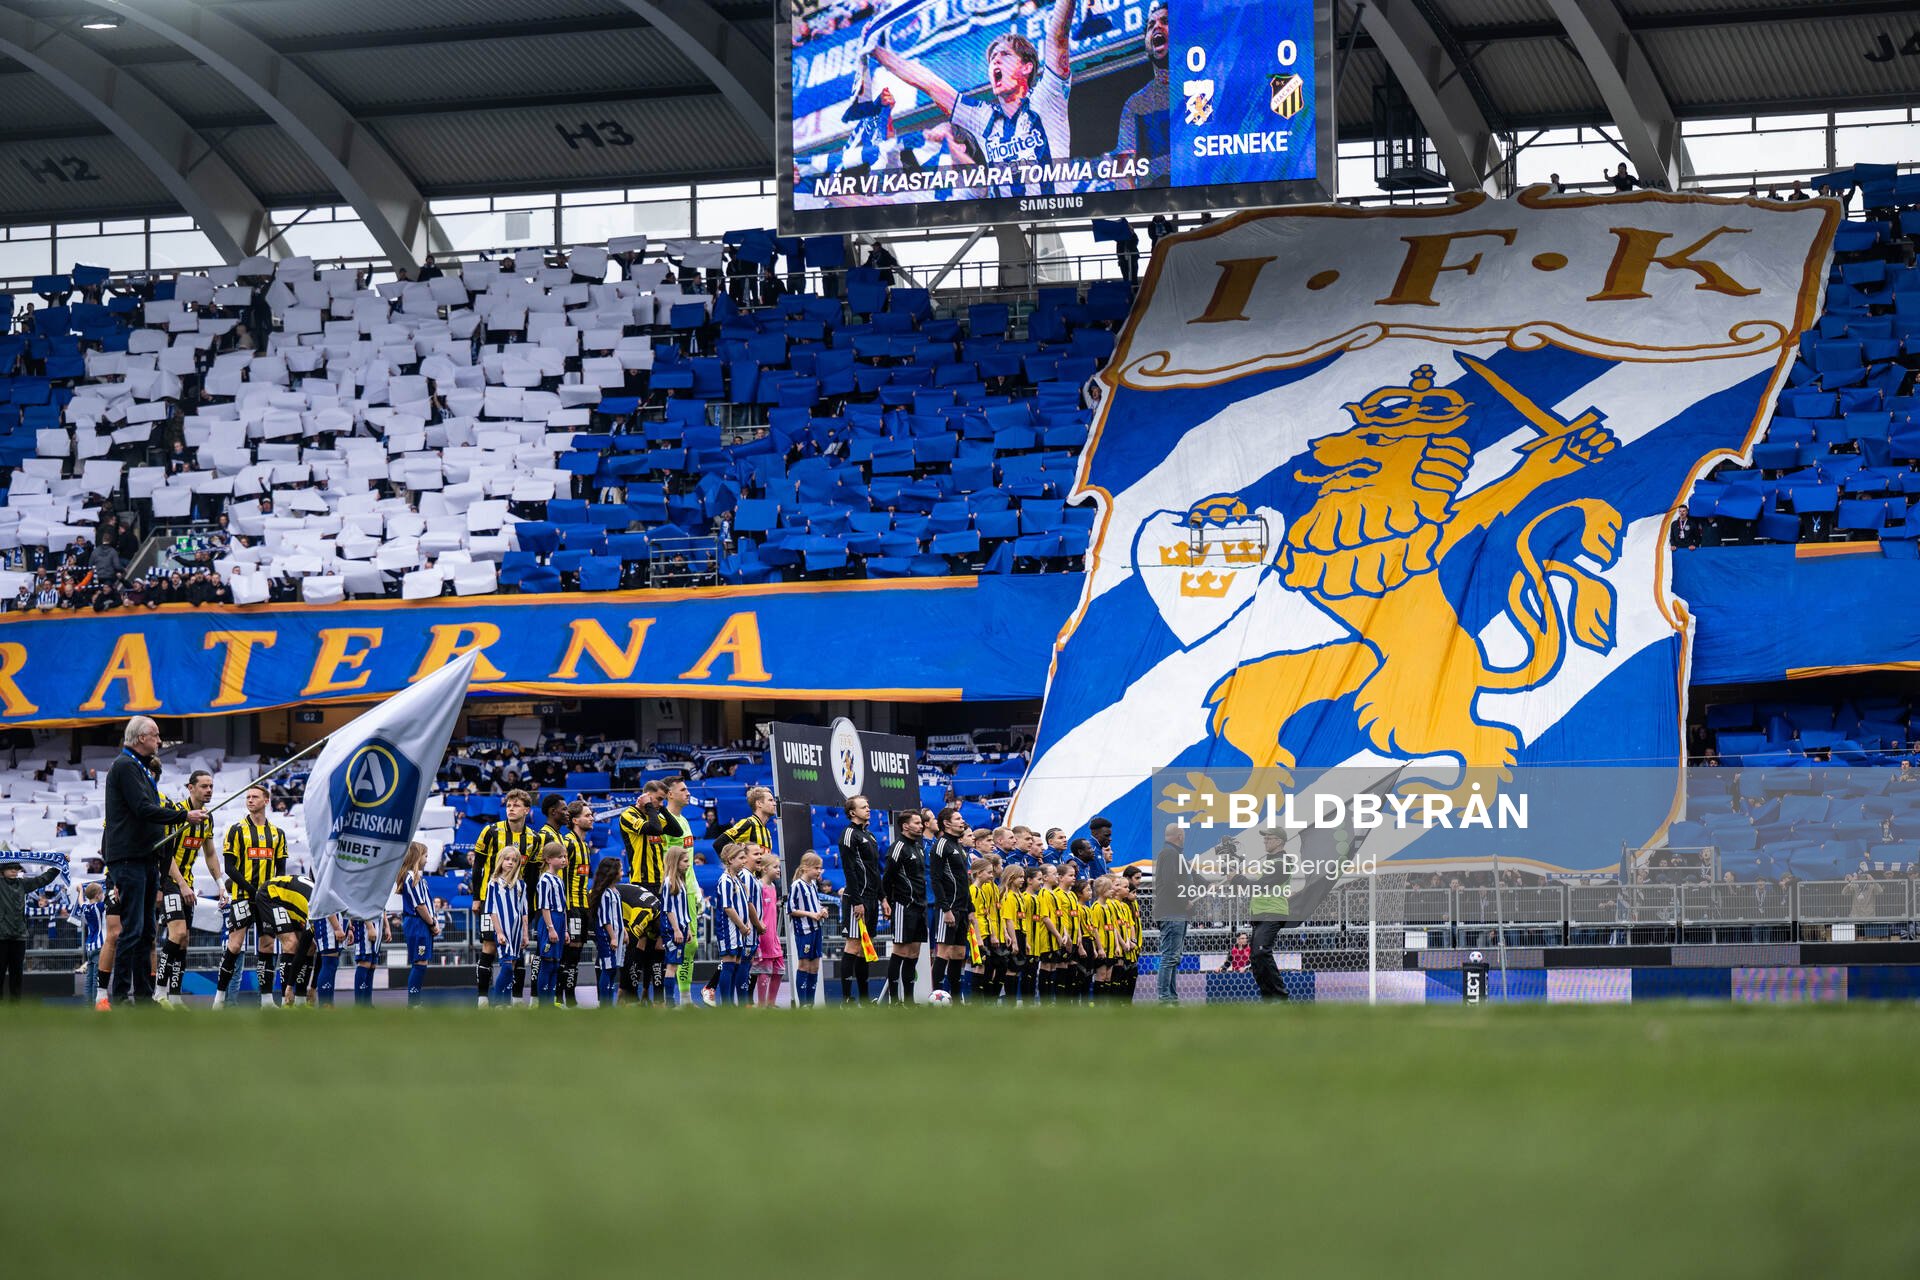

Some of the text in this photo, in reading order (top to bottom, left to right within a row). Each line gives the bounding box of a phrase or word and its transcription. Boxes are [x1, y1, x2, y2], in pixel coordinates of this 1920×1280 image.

[1186, 45, 1206, 72] 0
[1277, 39, 1297, 66] 0
[555, 120, 635, 149] H3
[19, 155, 101, 184] H2
[813, 174, 857, 197] NÄR
[860, 175, 880, 193] VI
[882, 170, 959, 193] KASTAR
[962, 164, 1014, 188] VÅRA
[1018, 162, 1093, 184] TOMMA
[1097, 157, 1150, 179] GLAS
[1020, 196, 1084, 211] SAMSUNG
[303, 712, 316, 721] G2
[542, 706, 554, 714] G3
[783, 741, 823, 766] UNIBET
[870, 750, 910, 775] UNIBET
